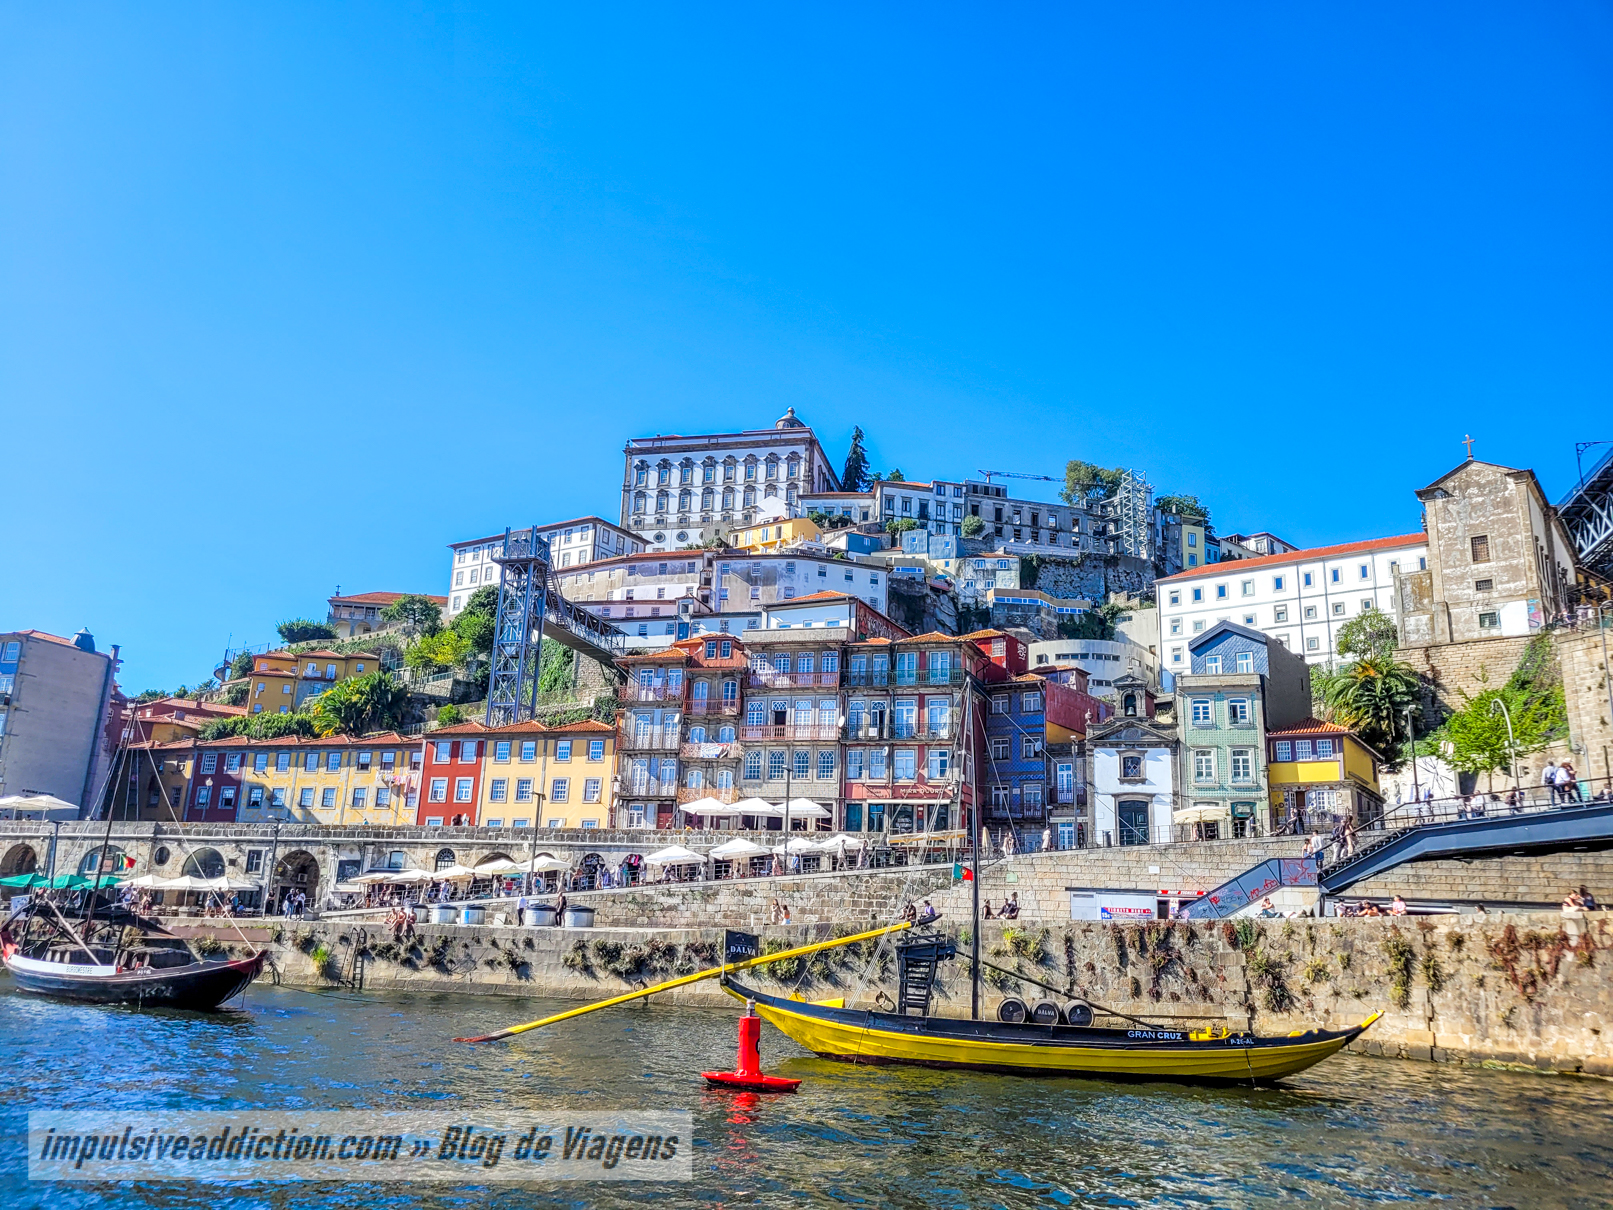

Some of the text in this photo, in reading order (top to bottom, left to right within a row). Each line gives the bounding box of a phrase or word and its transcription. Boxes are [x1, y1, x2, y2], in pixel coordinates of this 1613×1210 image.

[730, 945, 756, 957] DALVA
[65, 965, 93, 975] BURGOMESTRE
[1037, 1008, 1055, 1017] DALVA
[1127, 1030, 1183, 1040] GRAN CRUZ
